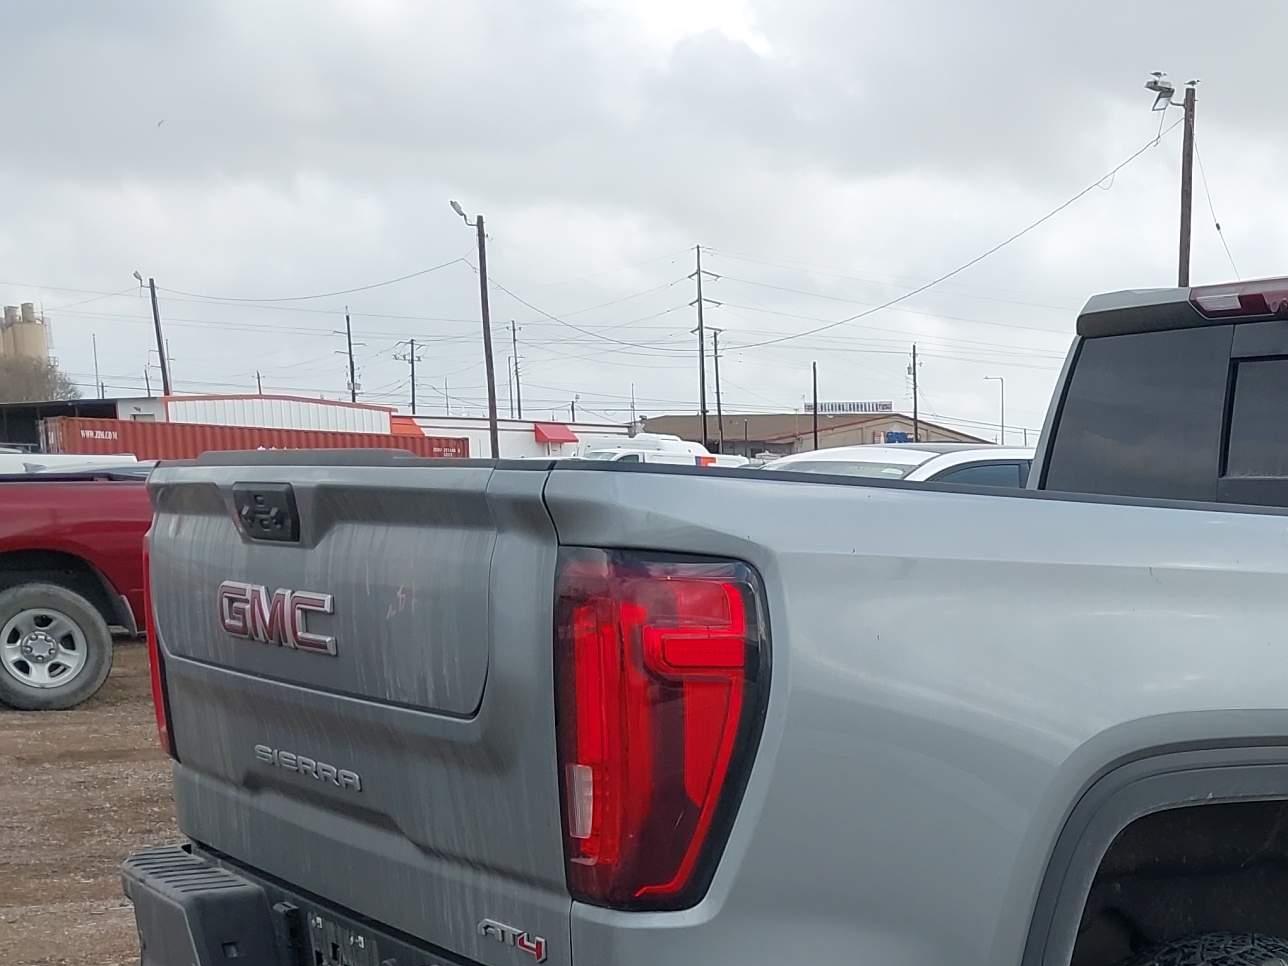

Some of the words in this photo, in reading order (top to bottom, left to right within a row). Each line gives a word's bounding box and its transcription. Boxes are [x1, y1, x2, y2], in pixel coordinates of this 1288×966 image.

[217, 580, 338, 656] GMC
[254, 744, 362, 792] SIERRA
[477, 918, 548, 964] AT4
